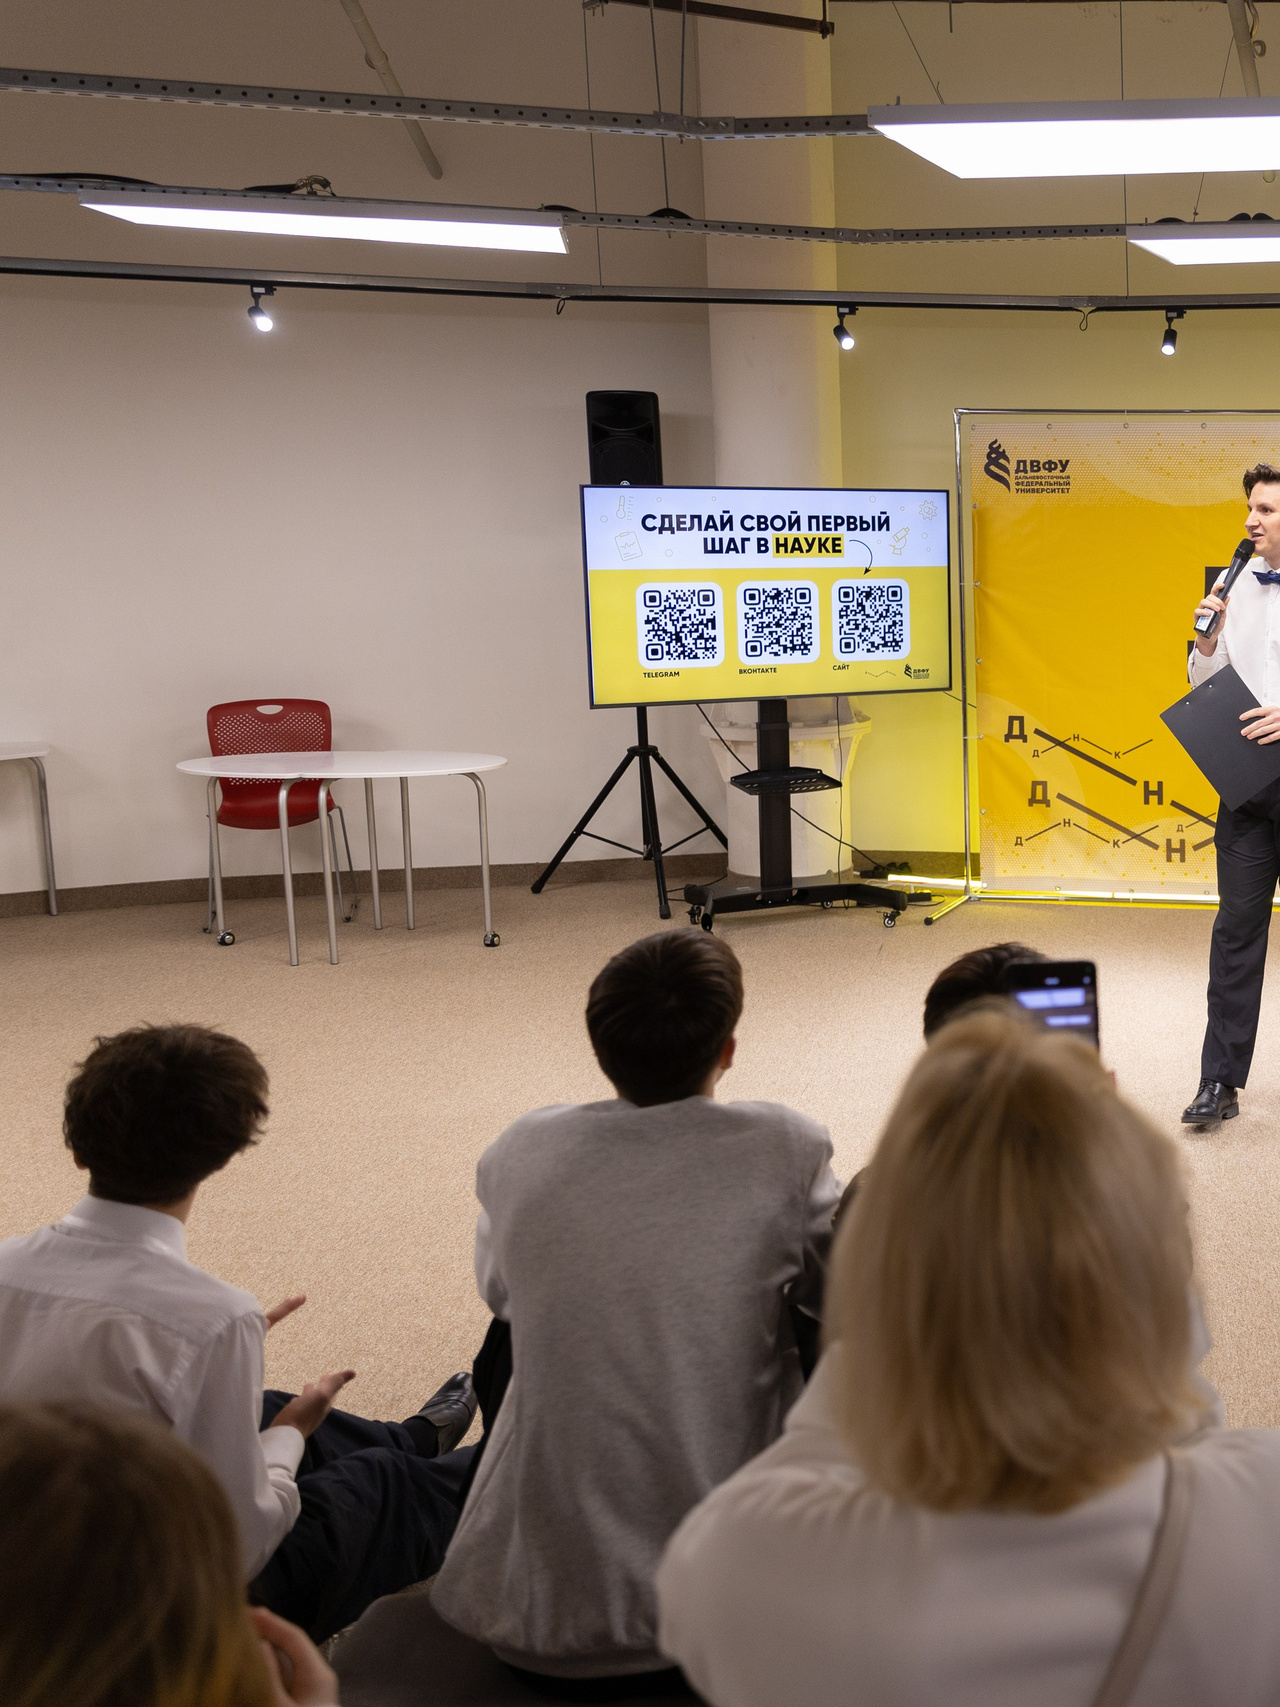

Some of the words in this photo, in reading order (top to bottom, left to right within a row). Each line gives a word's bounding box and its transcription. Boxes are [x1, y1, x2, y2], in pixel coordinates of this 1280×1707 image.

[1015, 460, 1070, 474] ДВФУ
[641, 510, 734, 534] СДЕЛАЙ
[740, 510, 801, 532] СВОЙ
[807, 511, 890, 532] ПЕРВЫЙ
[703, 537, 750, 554] ШАГ
[757, 537, 769, 554] В
[775, 537, 842, 554] НАУКЕ
[738, 667, 778, 675] ВКОНТАКТЕ
[832, 663, 850, 671] САЙТ
[642, 671, 680, 679] TELEGRAM
[1004, 716, 1028, 743] Д
[1143, 781, 1164, 806] Н
[1028, 781, 1051, 808] Д
[1166, 838, 1186, 863] Н
